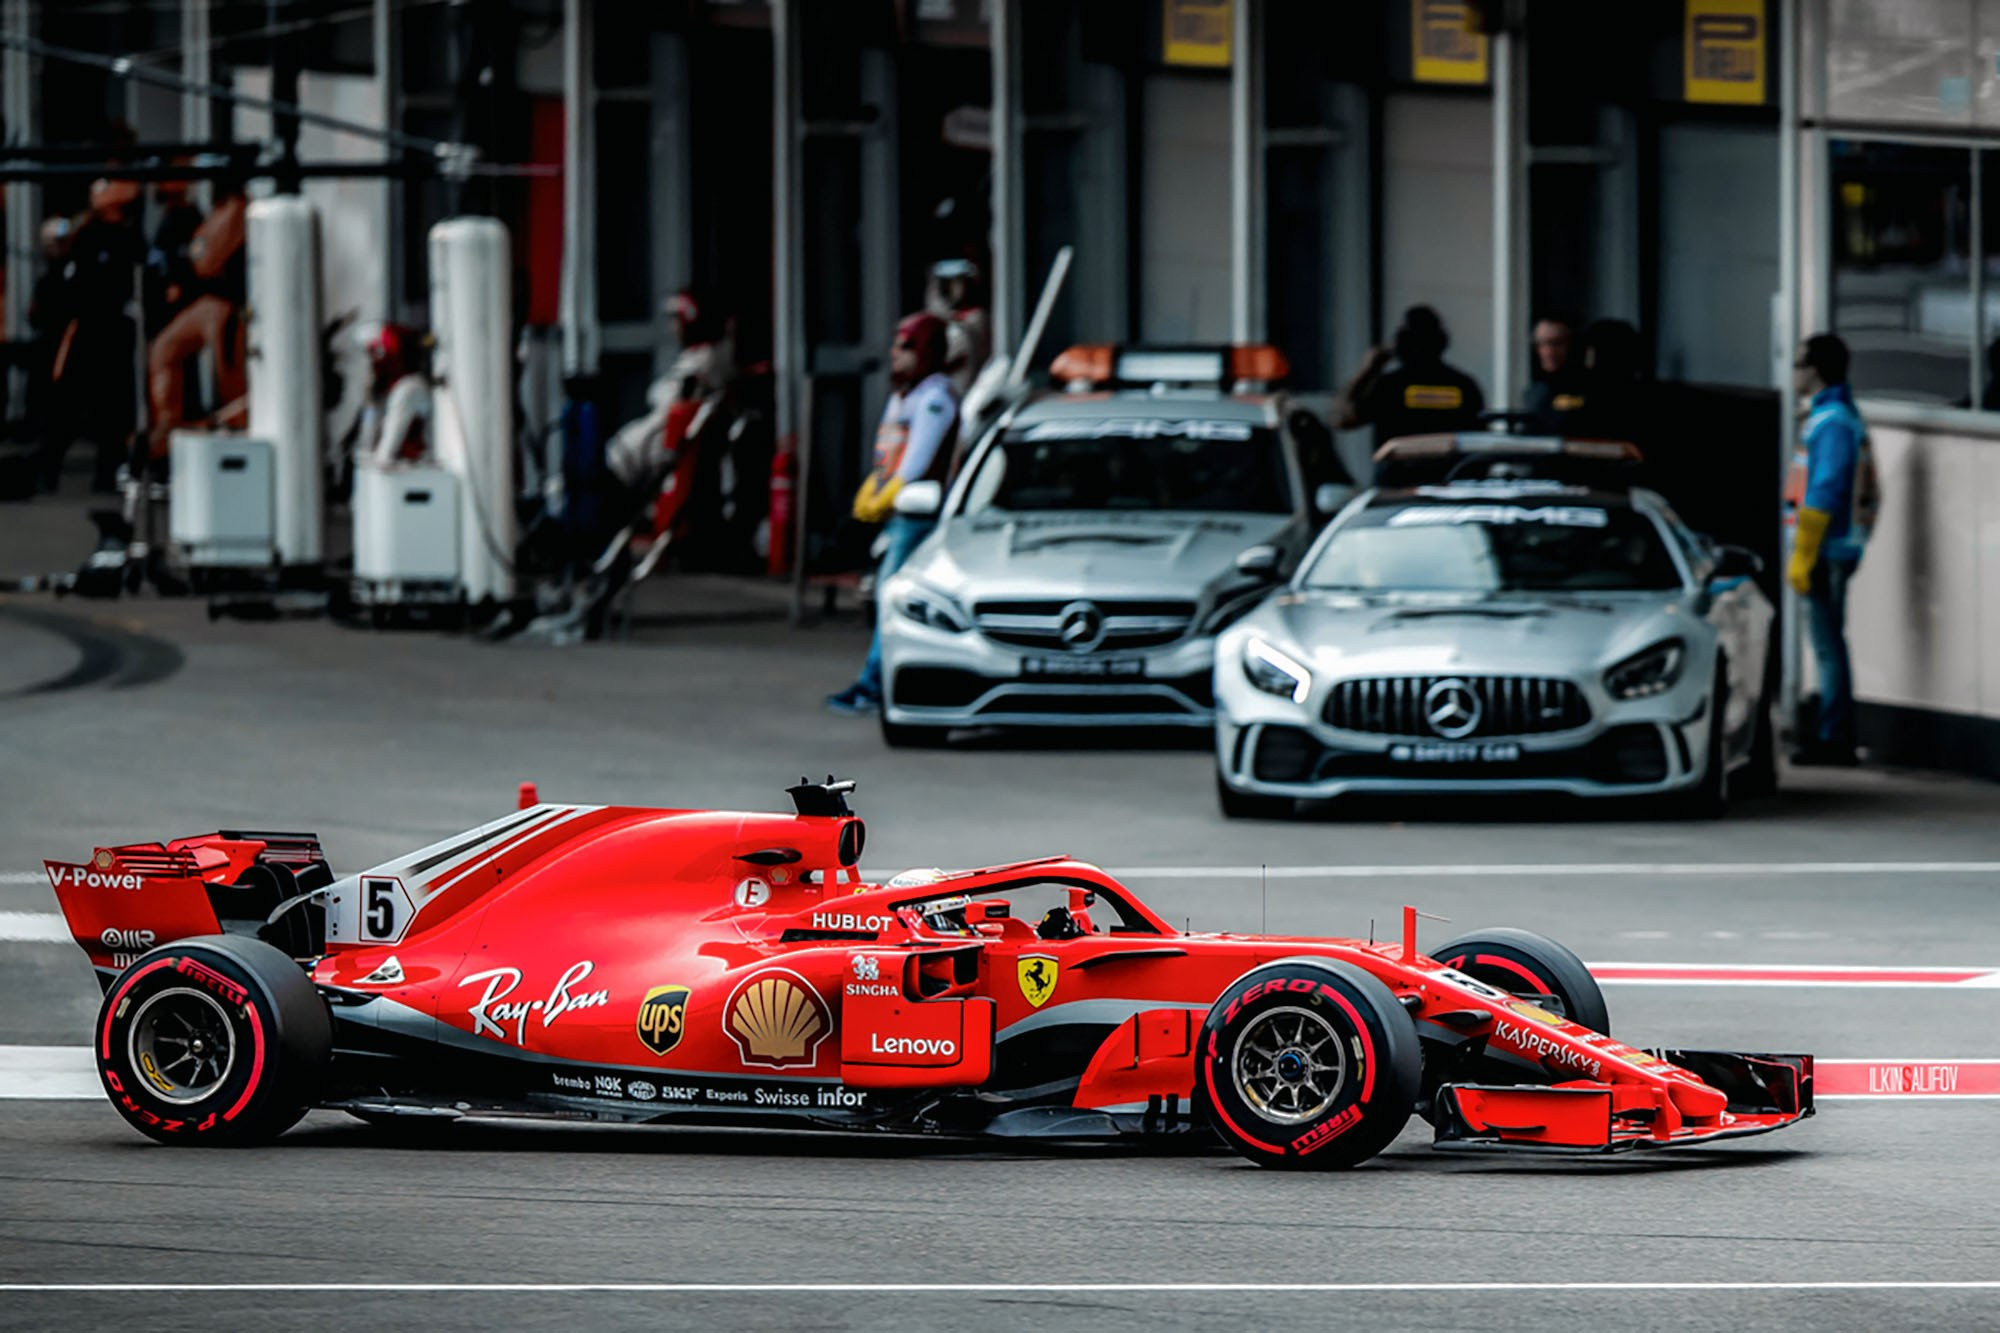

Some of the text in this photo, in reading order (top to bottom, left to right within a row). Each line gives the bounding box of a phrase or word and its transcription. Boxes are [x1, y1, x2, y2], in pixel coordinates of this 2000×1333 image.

[48, 866, 145, 890] V-Power
[744, 880, 761, 904] E
[366, 880, 393, 939] 5
[812, 912, 893, 932] HUBLOT
[176, 956, 249, 1006] PIRELLI
[845, 984, 899, 997] SINGHA
[1222, 978, 1317, 1025] ZERO
[640, 1002, 683, 1044] ups
[871, 1032, 956, 1057] Lenovo
[1494, 1020, 1592, 1070] KASPERSKY
[552, 1073, 591, 1090] brembo
[595, 1075, 623, 1092] NGK
[661, 1085, 700, 1100] SKF
[106, 1070, 185, 1132] ZERO
[706, 1088, 748, 1102] Experis
[754, 1087, 810, 1106] Swisse
[817, 1086, 867, 1106] infor
[1290, 1103, 1364, 1157] PIRELLI
